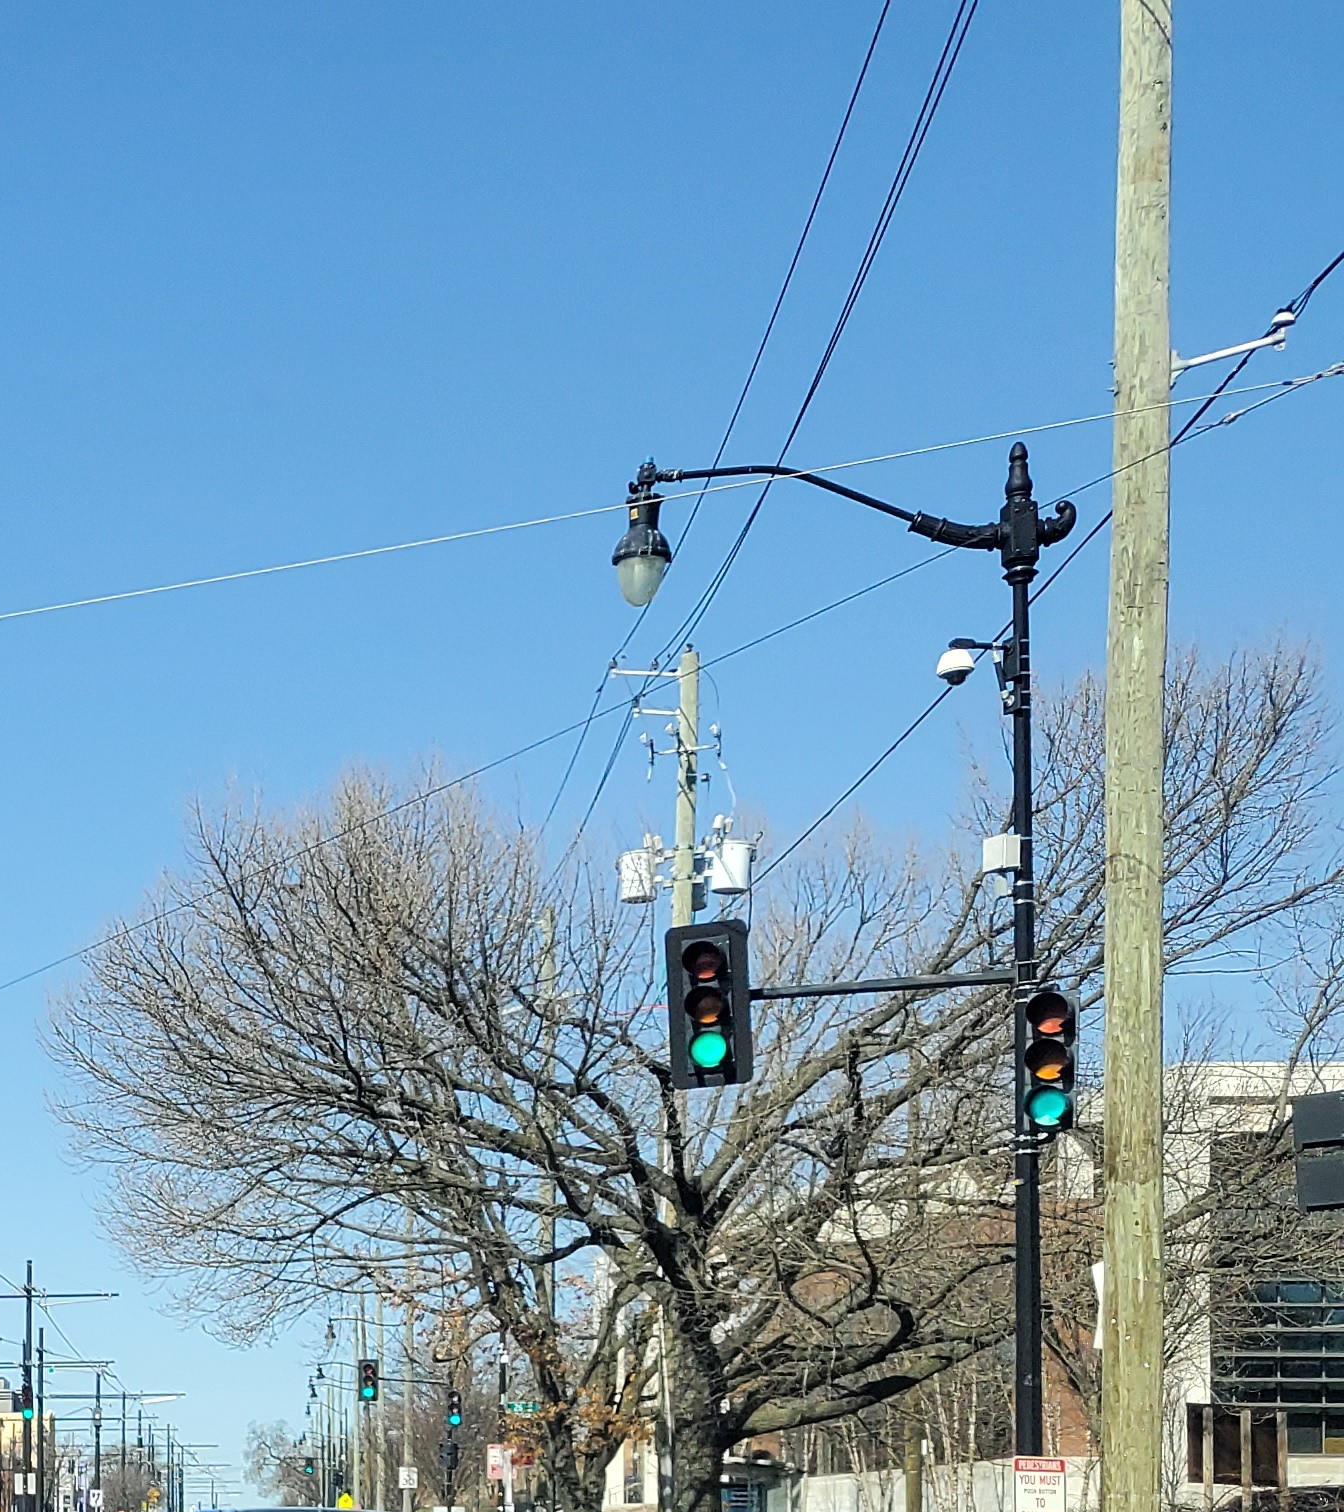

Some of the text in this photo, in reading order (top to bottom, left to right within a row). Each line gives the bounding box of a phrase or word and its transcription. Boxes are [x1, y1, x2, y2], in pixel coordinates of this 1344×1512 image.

[1019, 1475, 1061, 1486] YOU MUST
[1035, 1498, 1046, 1508] TO
